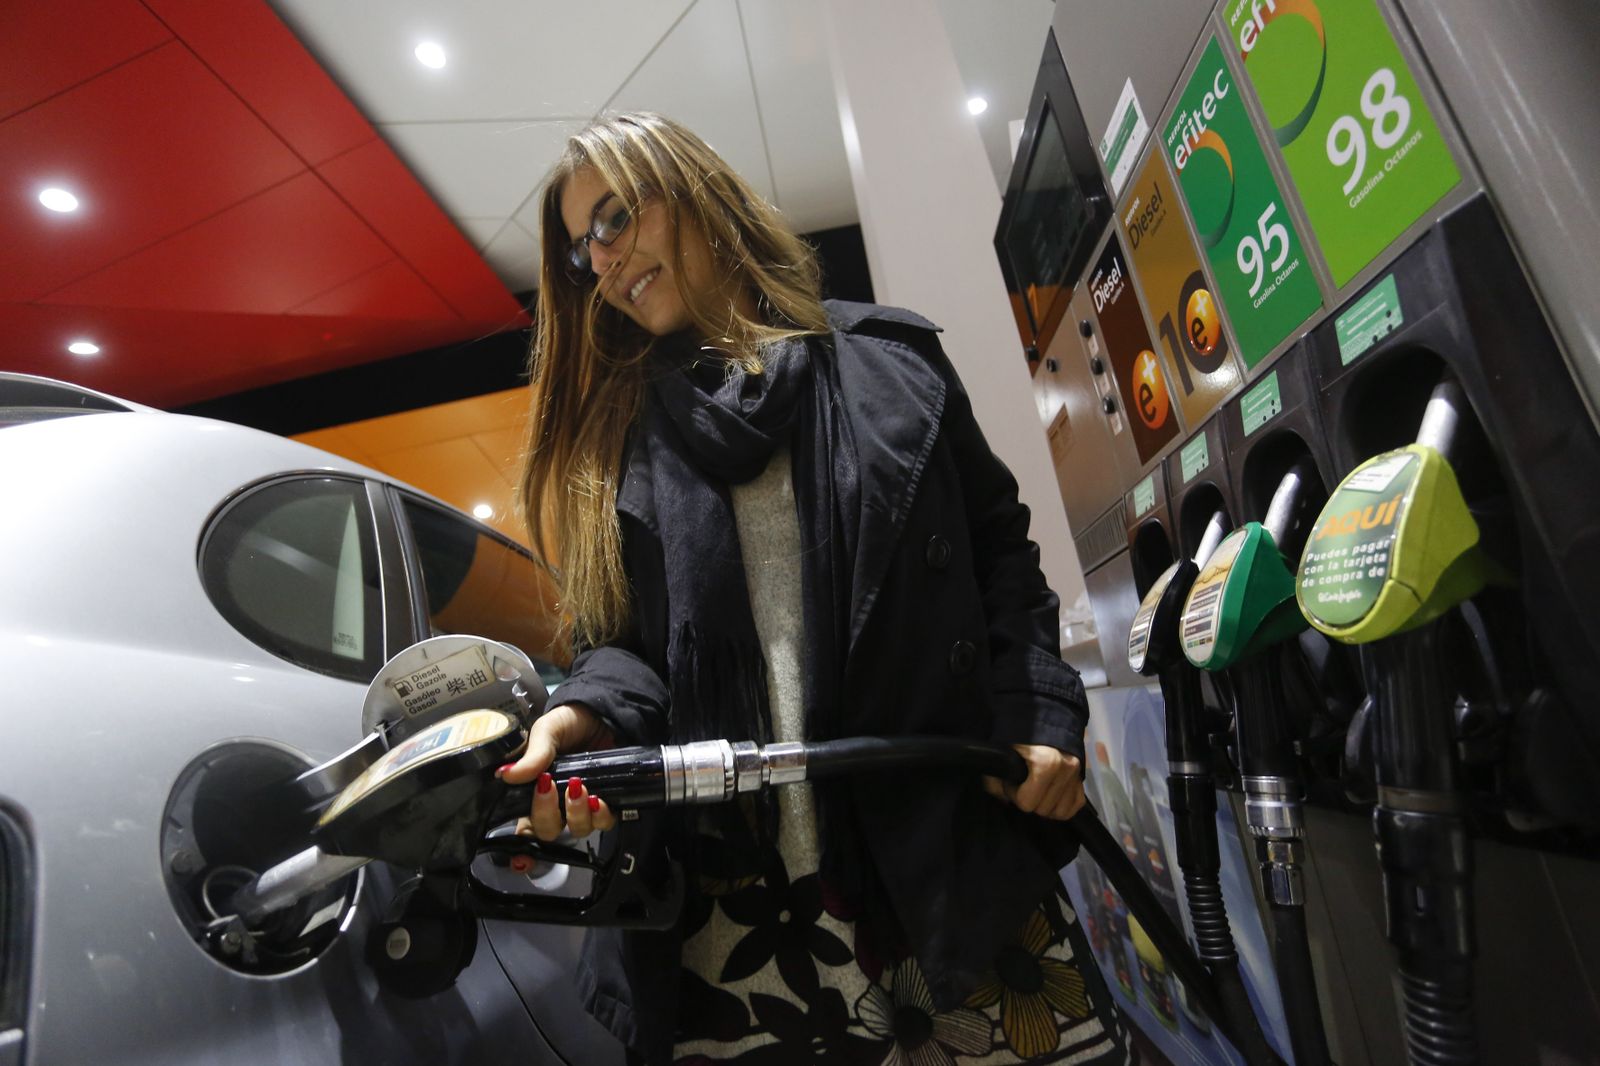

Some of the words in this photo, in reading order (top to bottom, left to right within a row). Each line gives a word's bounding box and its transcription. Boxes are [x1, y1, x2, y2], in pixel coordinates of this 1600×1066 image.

[1174, 68, 1229, 170] efitec
[1326, 67, 1411, 196] 98
[1349, 170, 1385, 208] Gasolina
[1384, 129, 1422, 171] Octanos
[1128, 181, 1163, 250] Diesel
[1236, 201, 1290, 298] 95
[1093, 256, 1122, 313] Diesel
[1253, 283, 1276, 309] Gasolina
[1275, 258, 1299, 286] Octanos
[1304, 564, 1324, 575] con
[1328, 558, 1339, 571] la
[1343, 552, 1387, 568] tarjeta
[1306, 547, 1348, 563] Puedes
[1352, 539, 1390, 556] pagar
[1302, 576, 1315, 588] de
[1319, 570, 1363, 586] compra
[1368, 565, 1386, 578] de
[411, 665, 441, 683] Diesel
[416, 672, 447, 690] Gazole
[446, 668, 488, 697] 柴油
[404, 688, 441, 708] Gasóleo
[408, 698, 438, 715] Gasoil
